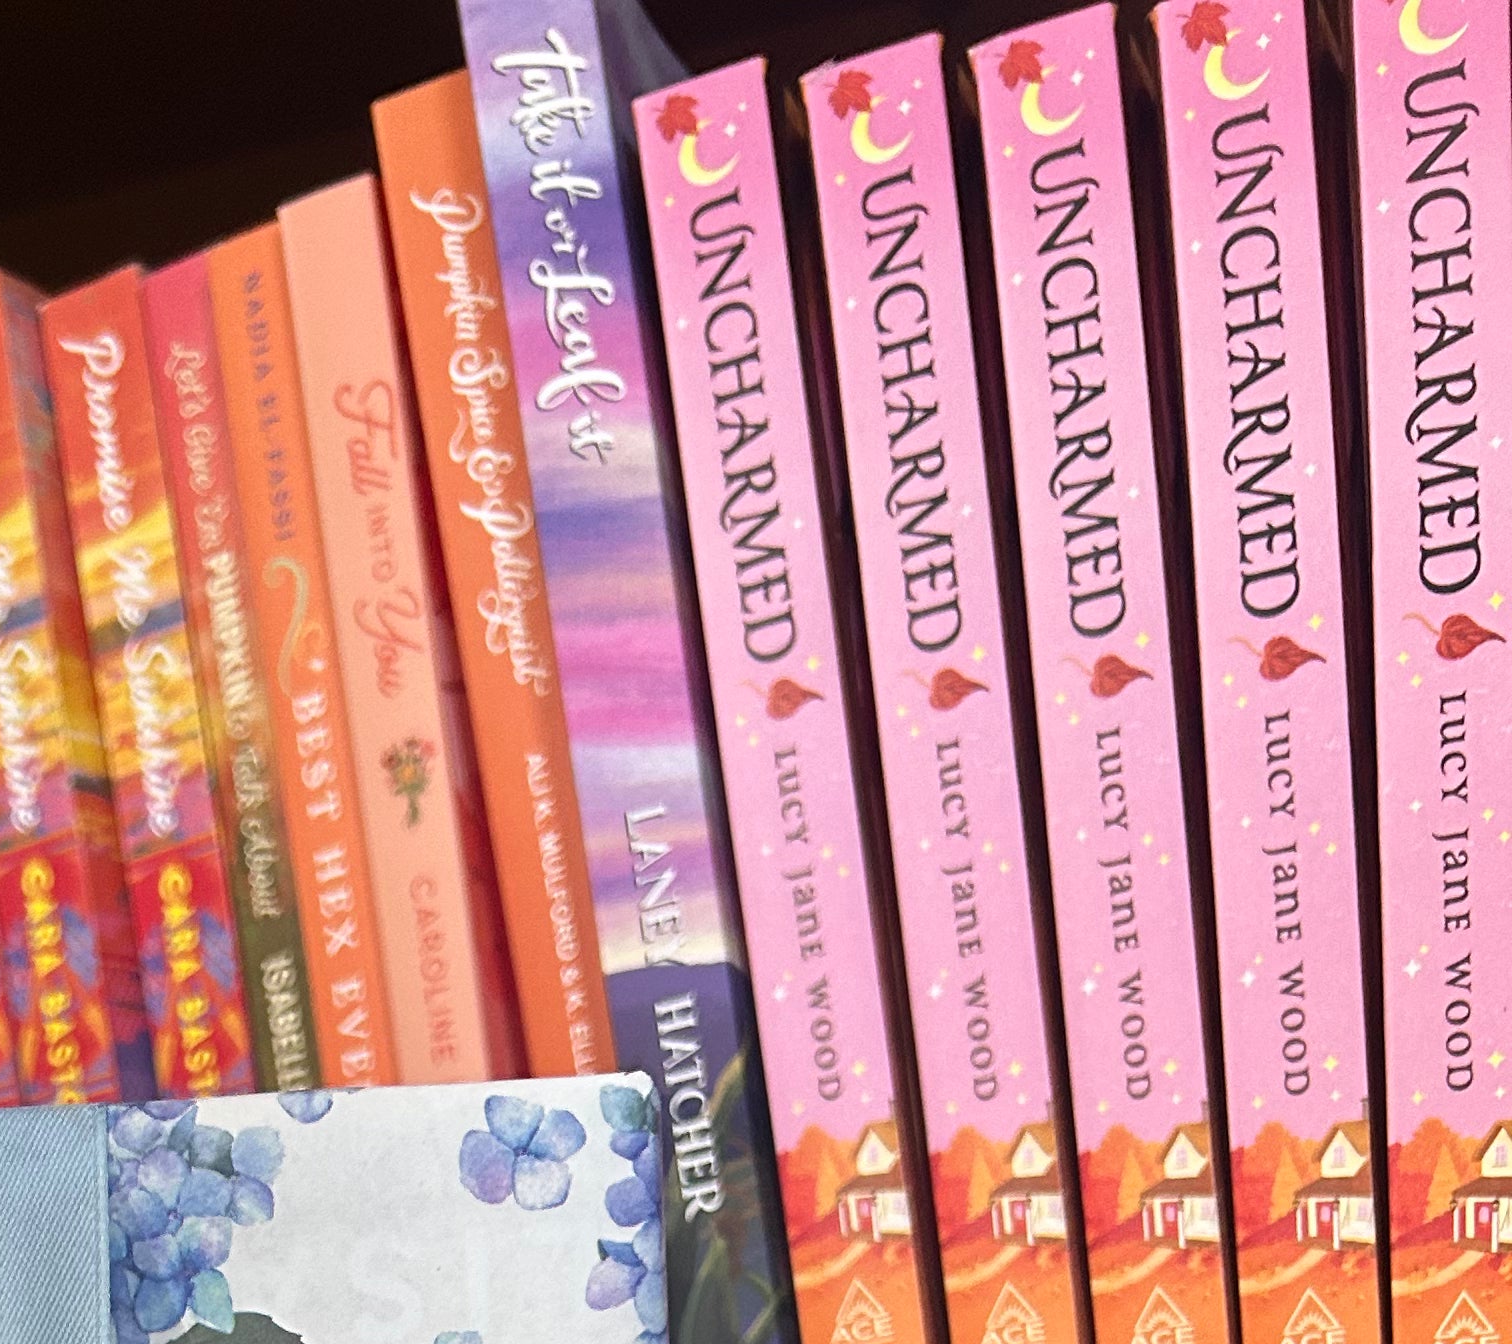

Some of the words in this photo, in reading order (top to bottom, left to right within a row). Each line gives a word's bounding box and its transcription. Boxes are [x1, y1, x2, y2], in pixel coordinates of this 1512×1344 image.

[492, 28, 593, 156] Take
[530, 158, 602, 206] it
[543, 207, 586, 263] or
[408, 188, 495, 340] Pumpkin
[528, 259, 626, 412] Leaf
[1029, 138, 1127, 638] UNCHARMED
[1210, 105, 1300, 618] UNCHARMED
[1404, 62, 1481, 595] UNCHARMED
[57, 333, 134, 532] Promise
[182, 423, 218, 493] Give
[333, 378, 399, 496] Fall
[447, 348, 508, 445] Spice
[567, 412, 615, 465] it
[689, 191, 797, 662] UNCHARMED
[859, 168, 963, 651] UNCHARMED
[106, 544, 151, 631] Me
[364, 503, 398, 582] INTO
[459, 499, 552, 698] Poltergeist
[202, 551, 254, 708] PUMPKIN
[352, 588, 420, 699] You
[124, 643, 185, 838] Sunshine
[229, 745, 266, 809] Talk
[289, 693, 341, 821] BEST
[523, 753, 553, 793] ALI
[1265, 711, 1295, 818] LUCY
[1440, 692, 1470, 802] LUCY
[21, 860, 60, 978] CARA
[159, 866, 199, 982] CARA
[239, 818, 279, 920] About
[312, 845, 358, 958] HEX
[539, 832, 574, 960] MULFORD
[623, 806, 683, 970] LANEY
[773, 747, 806, 847] LUCY
[806, 980, 843, 1102] WOOD
[936, 739, 968, 838] LUCY
[963, 975, 999, 1102] WOOD
[1097, 726, 1128, 830] LUCY
[1119, 972, 1151, 1101] WOOD
[408, 878, 457, 1065] CAROLINE
[559, 967, 577, 984] &
[563, 989, 586, 1018] K.
[1278, 970, 1310, 1097] WOOD
[1445, 953, 1474, 1092] WOOD
[652, 993, 724, 1222] HATCHER
[831, 1322, 893, 1342] ACE
[982, 1326, 1045, 1344] ACE
